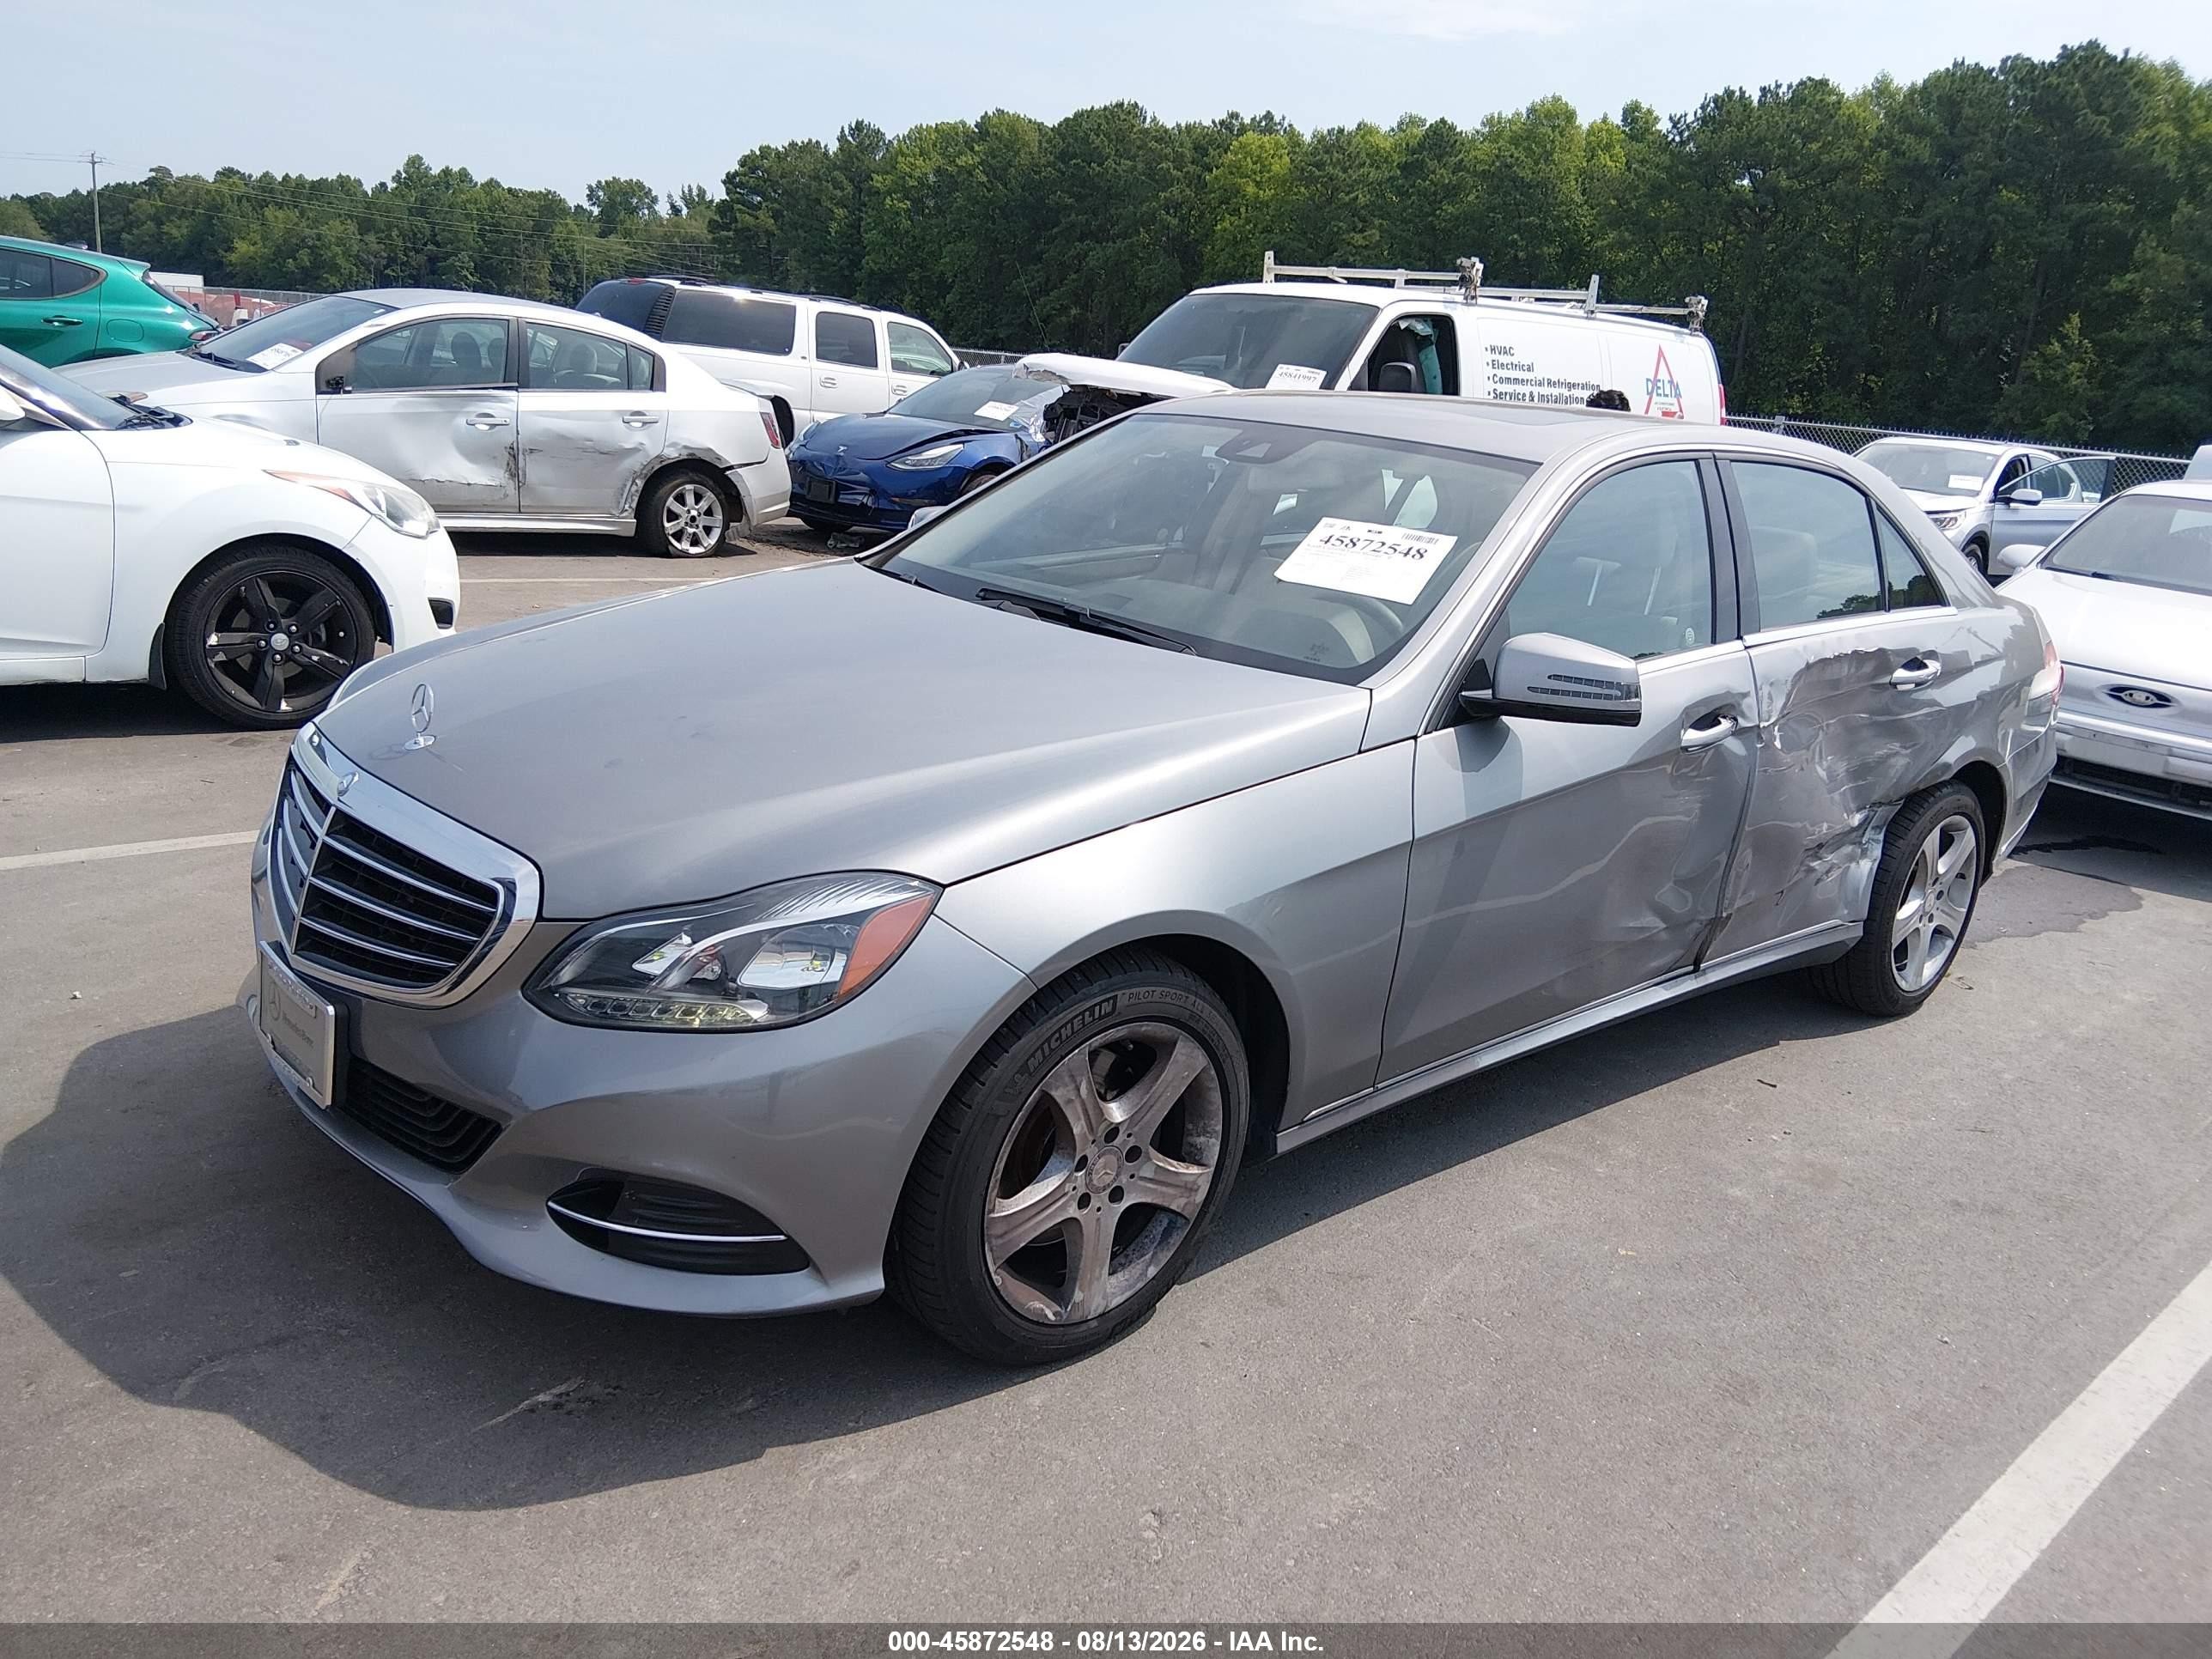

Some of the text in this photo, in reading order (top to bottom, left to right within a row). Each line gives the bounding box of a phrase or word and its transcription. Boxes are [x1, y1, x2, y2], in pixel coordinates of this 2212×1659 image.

[1490, 344, 1515, 357] HVAC
[1492, 359, 1534, 373] Electrical
[1492, 374, 1601, 392] Commercial Refrigeration
[1645, 377, 1682, 399] DELTA
[1492, 388, 1585, 406] Service & Installation
[1319, 533, 1429, 561] 45872548
[1027, 1000, 1115, 1073] MICHELIN
[1127, 989, 1157, 1003] PILOT
[1158, 990, 1190, 1003] SPORT
